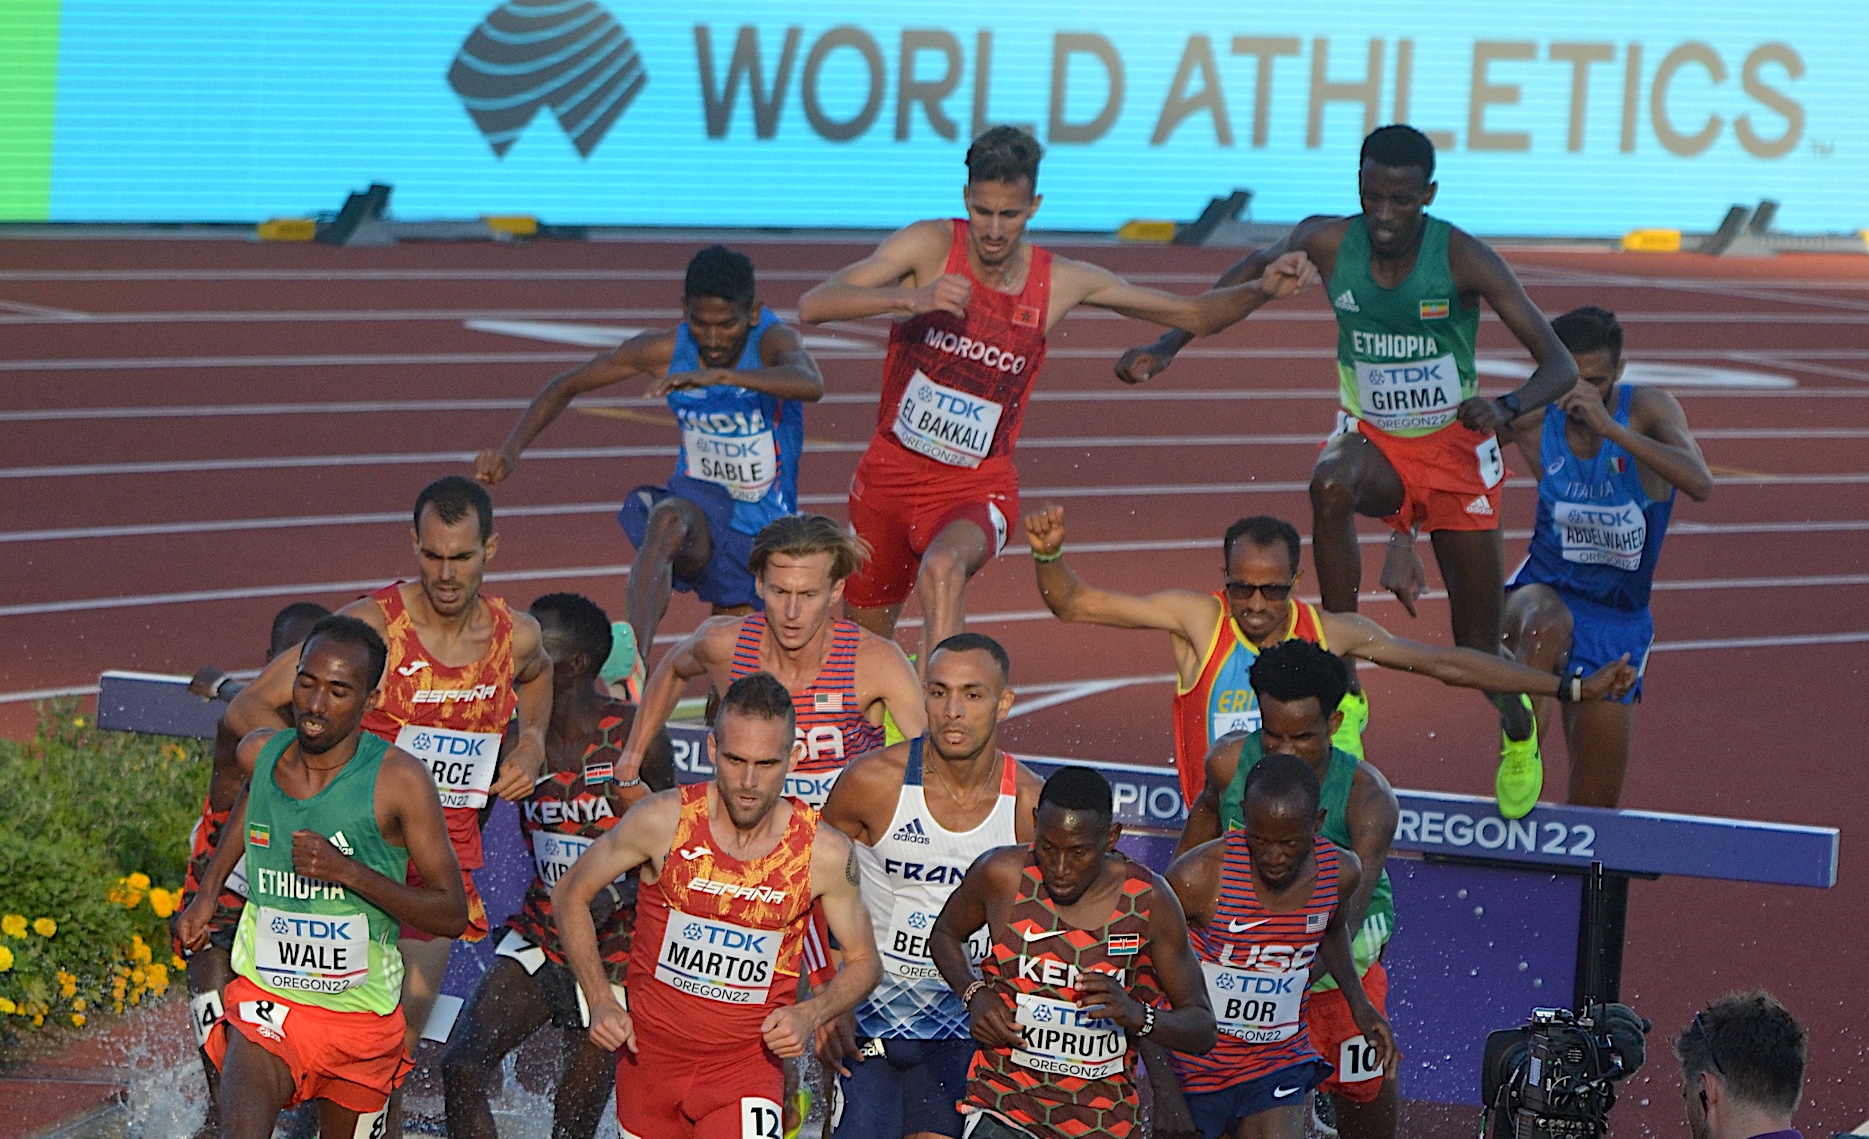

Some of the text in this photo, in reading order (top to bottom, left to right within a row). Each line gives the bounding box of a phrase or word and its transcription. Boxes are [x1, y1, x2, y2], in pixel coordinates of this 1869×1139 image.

[693, 23, 1126, 145] WORLD
[1150, 35, 1806, 160] ATHLETICS
[925, 327, 1027, 375] MOROCCO
[1353, 331, 1439, 359] ETHIOPIA
[1384, 364, 1444, 385] TDK
[935, 391, 986, 422] TDK
[1371, 386, 1448, 411] GIRMA
[902, 398, 989, 453] EL BAKKALI
[1377, 414, 1448, 430] OREGON22
[708, 439, 761, 458] TDK
[902, 431, 967, 465] OREGON22
[701, 457, 764, 482] SABLE
[1565, 481, 1615, 499] ITALIA
[1581, 508, 1635, 528] TDK
[1567, 525, 1646, 551] ABDELWAHED
[411, 683, 498, 704] ESPAÑA
[1217, 689, 1260, 713] ERI
[433, 734, 487, 757] TDK
[424, 758, 475, 786] RCE
[440, 793, 470, 806] ON22
[783, 777, 835, 796] TDK
[523, 796, 615, 825] KENYA
[893, 831, 930, 845] adidas
[1394, 808, 1596, 858] REGON22
[558, 840, 589, 858] TD
[885, 858, 967, 885] FRAN
[687, 877, 787, 904] ESPAÑA
[288, 918, 352, 940] TDK
[704, 925, 768, 954] TDK
[278, 941, 348, 970] WALE
[667, 941, 769, 983] MARTOS
[1219, 942, 1320, 973] USA
[272, 974, 351, 992] OREGON22
[672, 976, 750, 1002] OREGON22
[1236, 975, 1295, 995] TDK
[1225, 998, 1278, 1023] BOR
[1021, 1024, 1119, 1058] KIPRUTO
[1029, 1057, 1108, 1078] OREGON22
[1347, 1044, 1378, 1075] 10
[750, 1106, 780, 1139] 12
